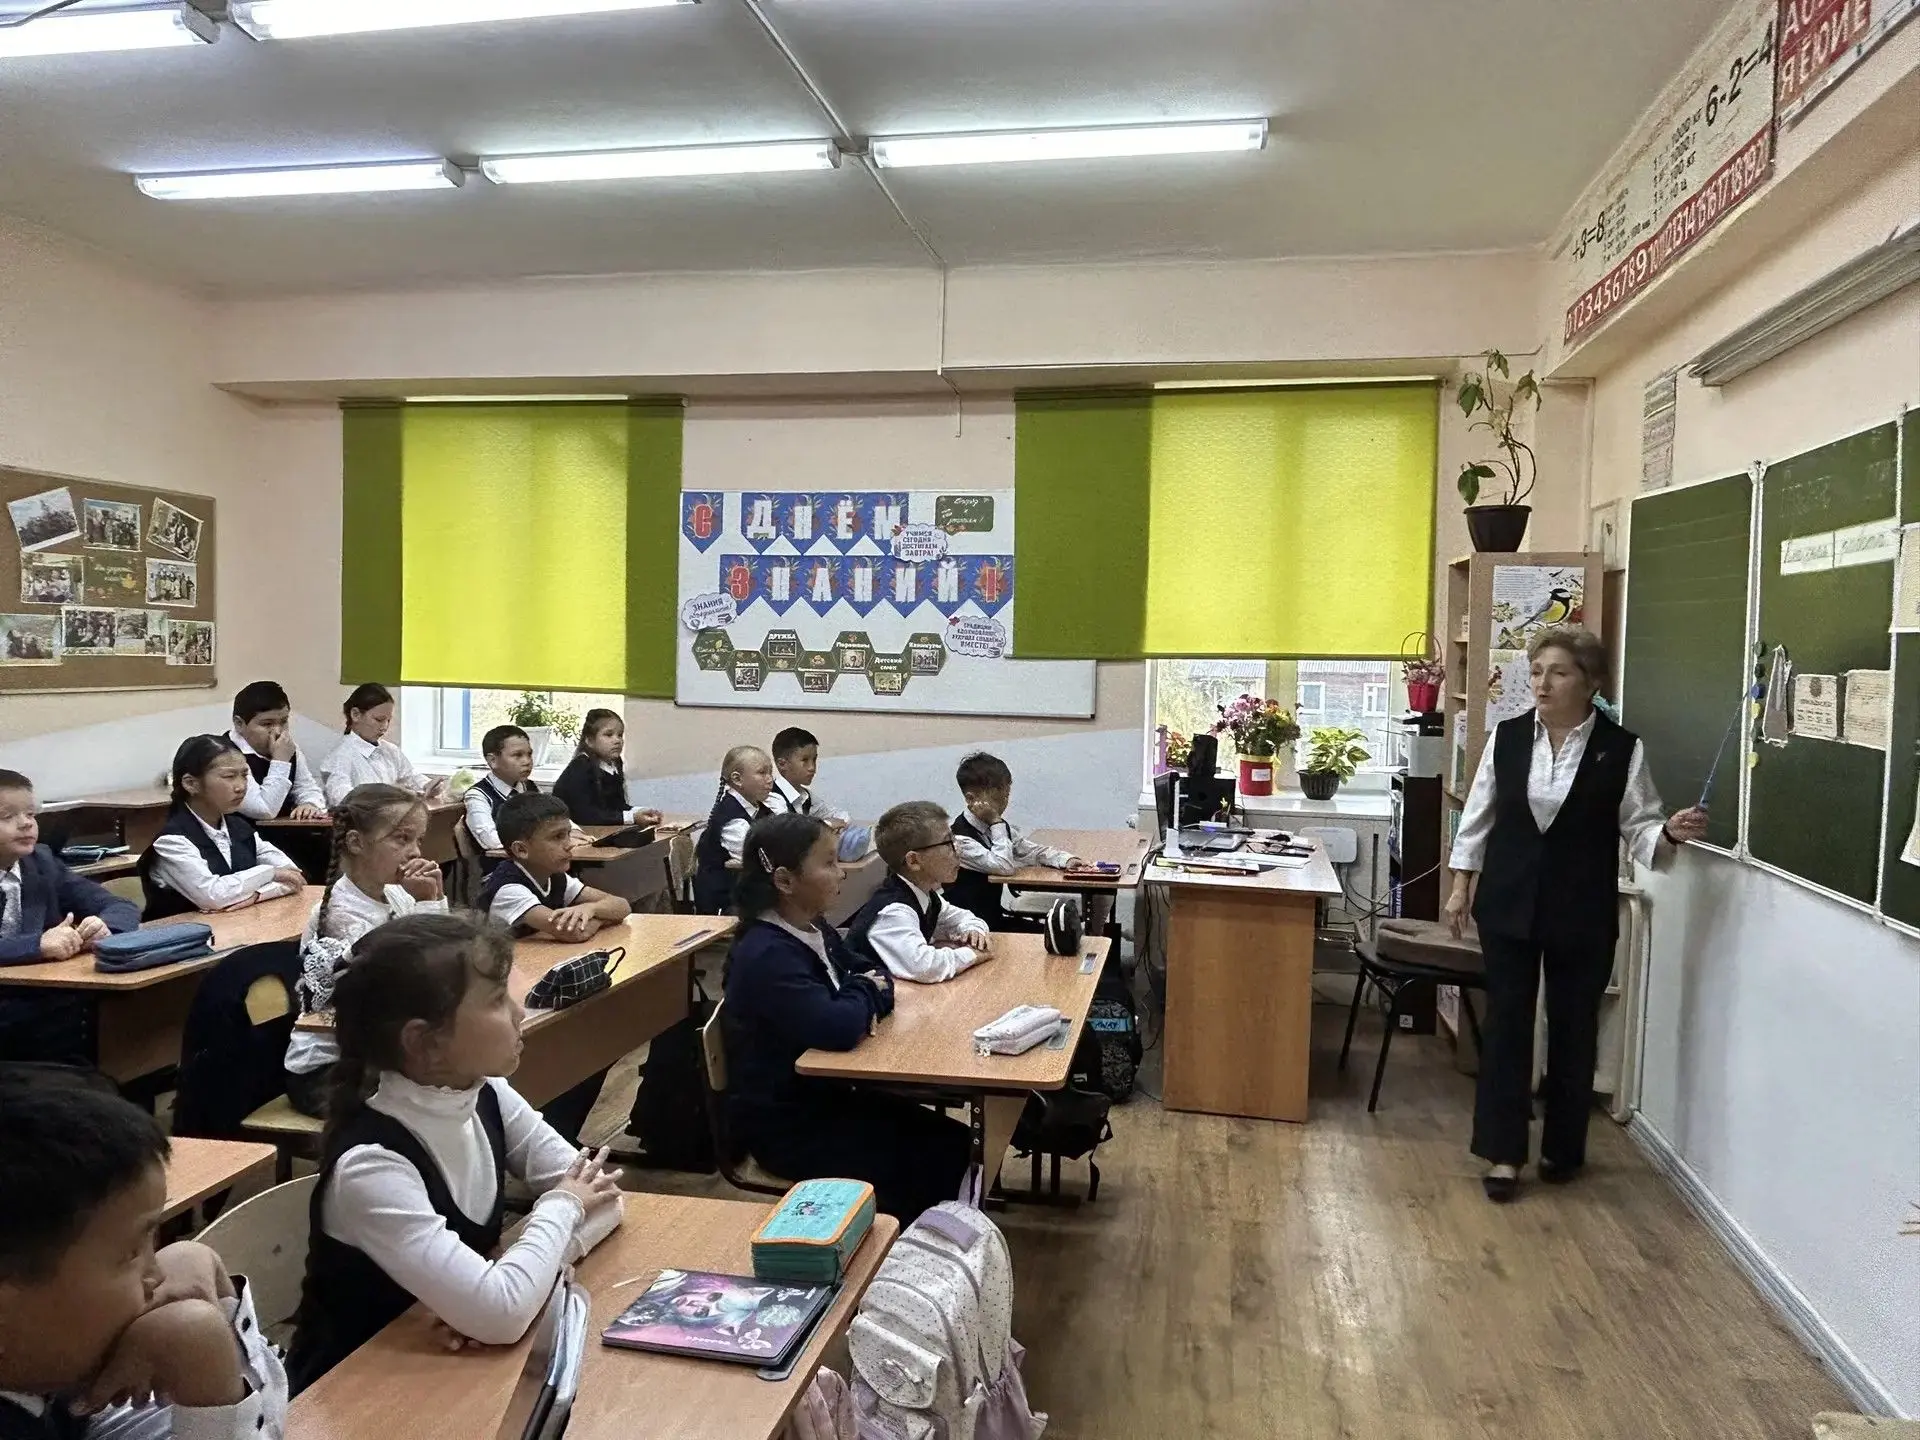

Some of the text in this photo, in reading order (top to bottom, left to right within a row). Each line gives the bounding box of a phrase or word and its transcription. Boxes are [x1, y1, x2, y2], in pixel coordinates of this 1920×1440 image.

[694, 499, 901, 540] С ДНЁМ
[730, 560, 998, 602] ЗНАНИЙ!
[692, 598, 724, 613] ЗНАНИЯ
